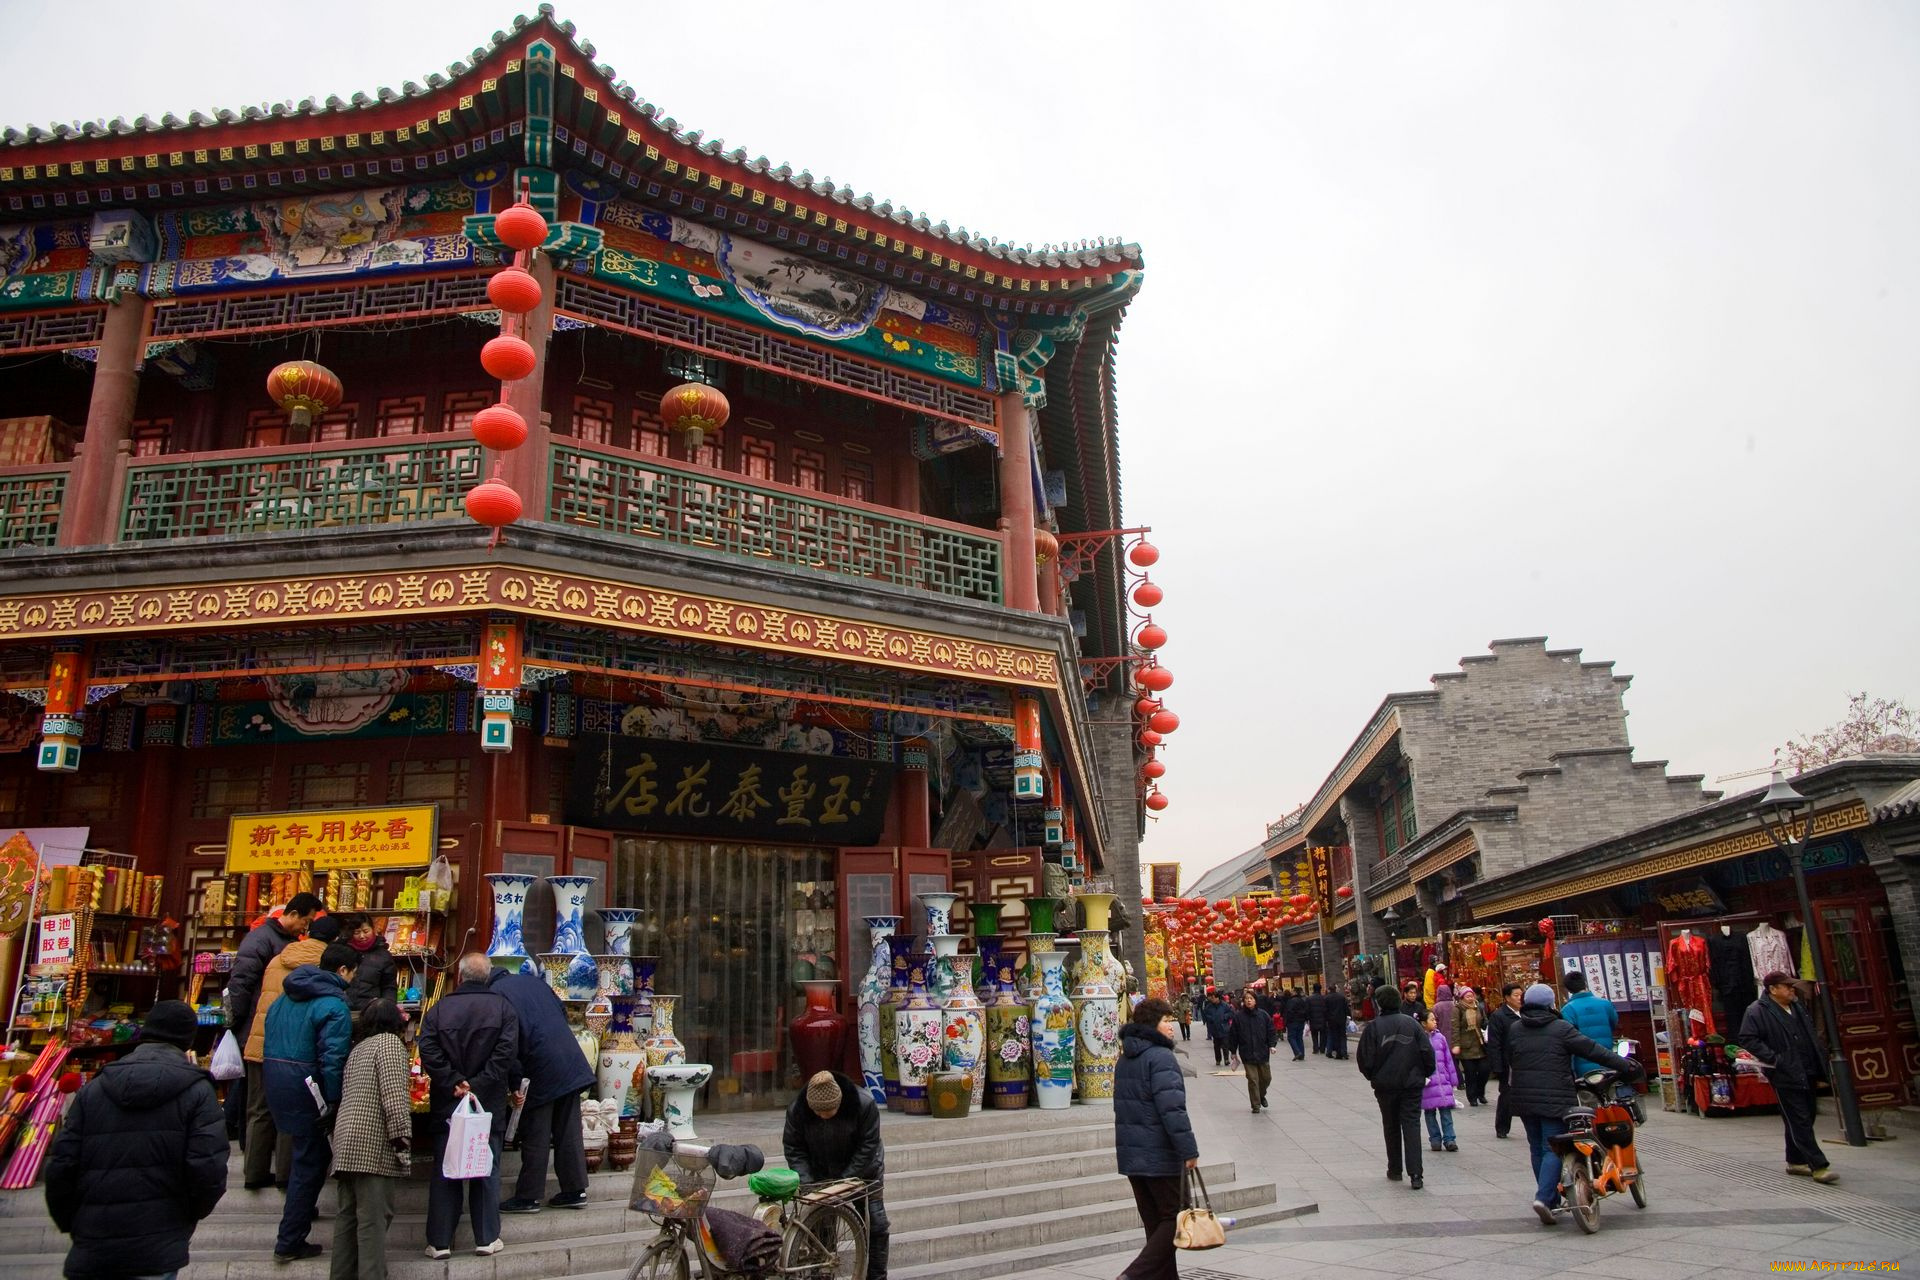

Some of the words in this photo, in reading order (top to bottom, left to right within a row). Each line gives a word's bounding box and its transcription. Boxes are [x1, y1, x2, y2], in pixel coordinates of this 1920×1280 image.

[249, 816, 413, 847] 新年用好香
[43, 917, 71, 932] 电池
[42, 937, 70, 951] 胶卷
